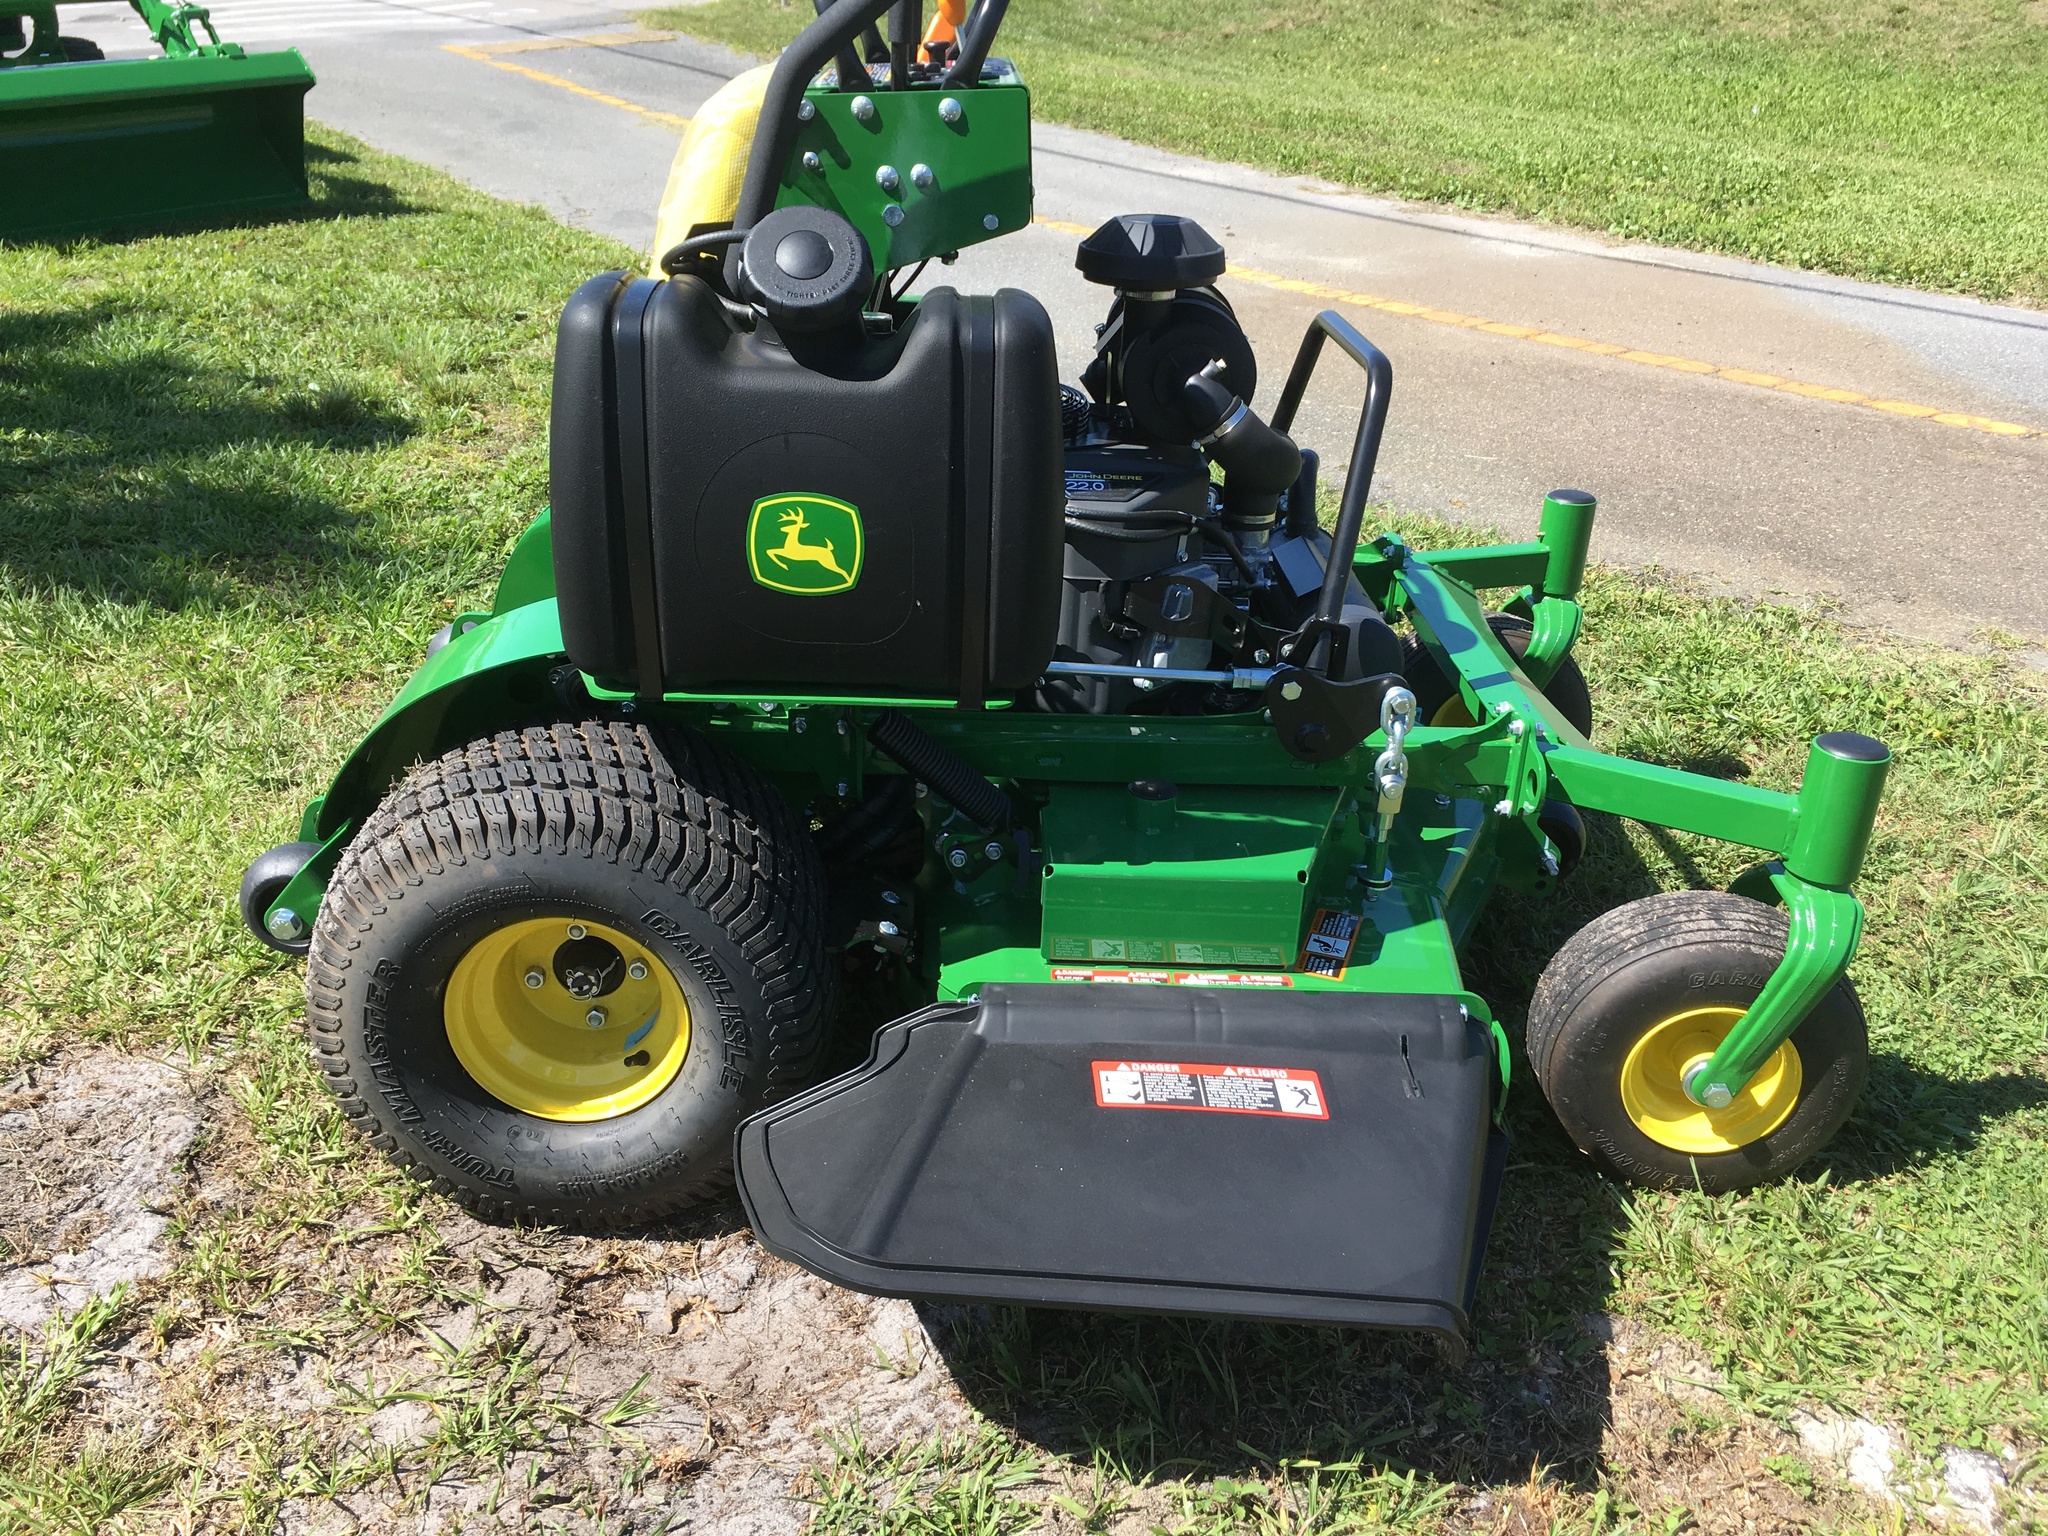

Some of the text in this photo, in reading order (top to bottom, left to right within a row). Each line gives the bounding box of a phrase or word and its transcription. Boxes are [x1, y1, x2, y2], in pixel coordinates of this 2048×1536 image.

[840, 261, 854, 283] THREE
[1066, 481, 1105, 491] 22.0
[640, 908, 753, 1092] CARLISLE
[363, 957, 515, 1188] TURF MASTER
[1131, 1063, 1180, 1073] DANGER
[1236, 1067, 1288, 1079] PELIGRO
